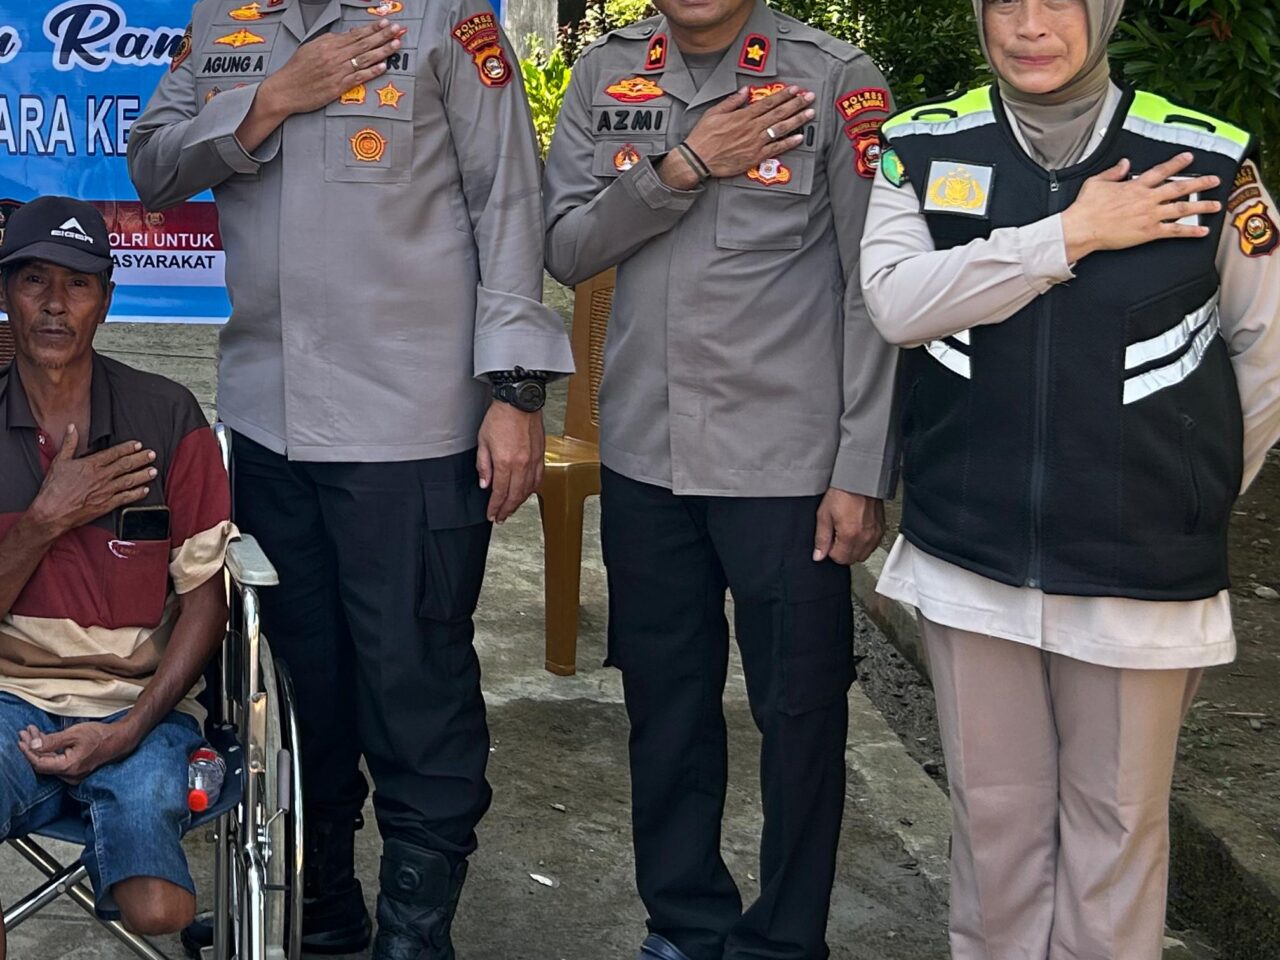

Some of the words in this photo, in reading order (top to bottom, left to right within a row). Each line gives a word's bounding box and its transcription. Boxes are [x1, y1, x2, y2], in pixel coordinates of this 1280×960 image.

[455, 14, 492, 38] POLRES
[202, 55, 251, 73] AGUNG
[253, 55, 264, 72] A
[842, 91, 883, 109] POLRES
[597, 110, 663, 131] AZMI
[50, 229, 94, 244] EIGER
[153, 232, 215, 248] UNTUK
